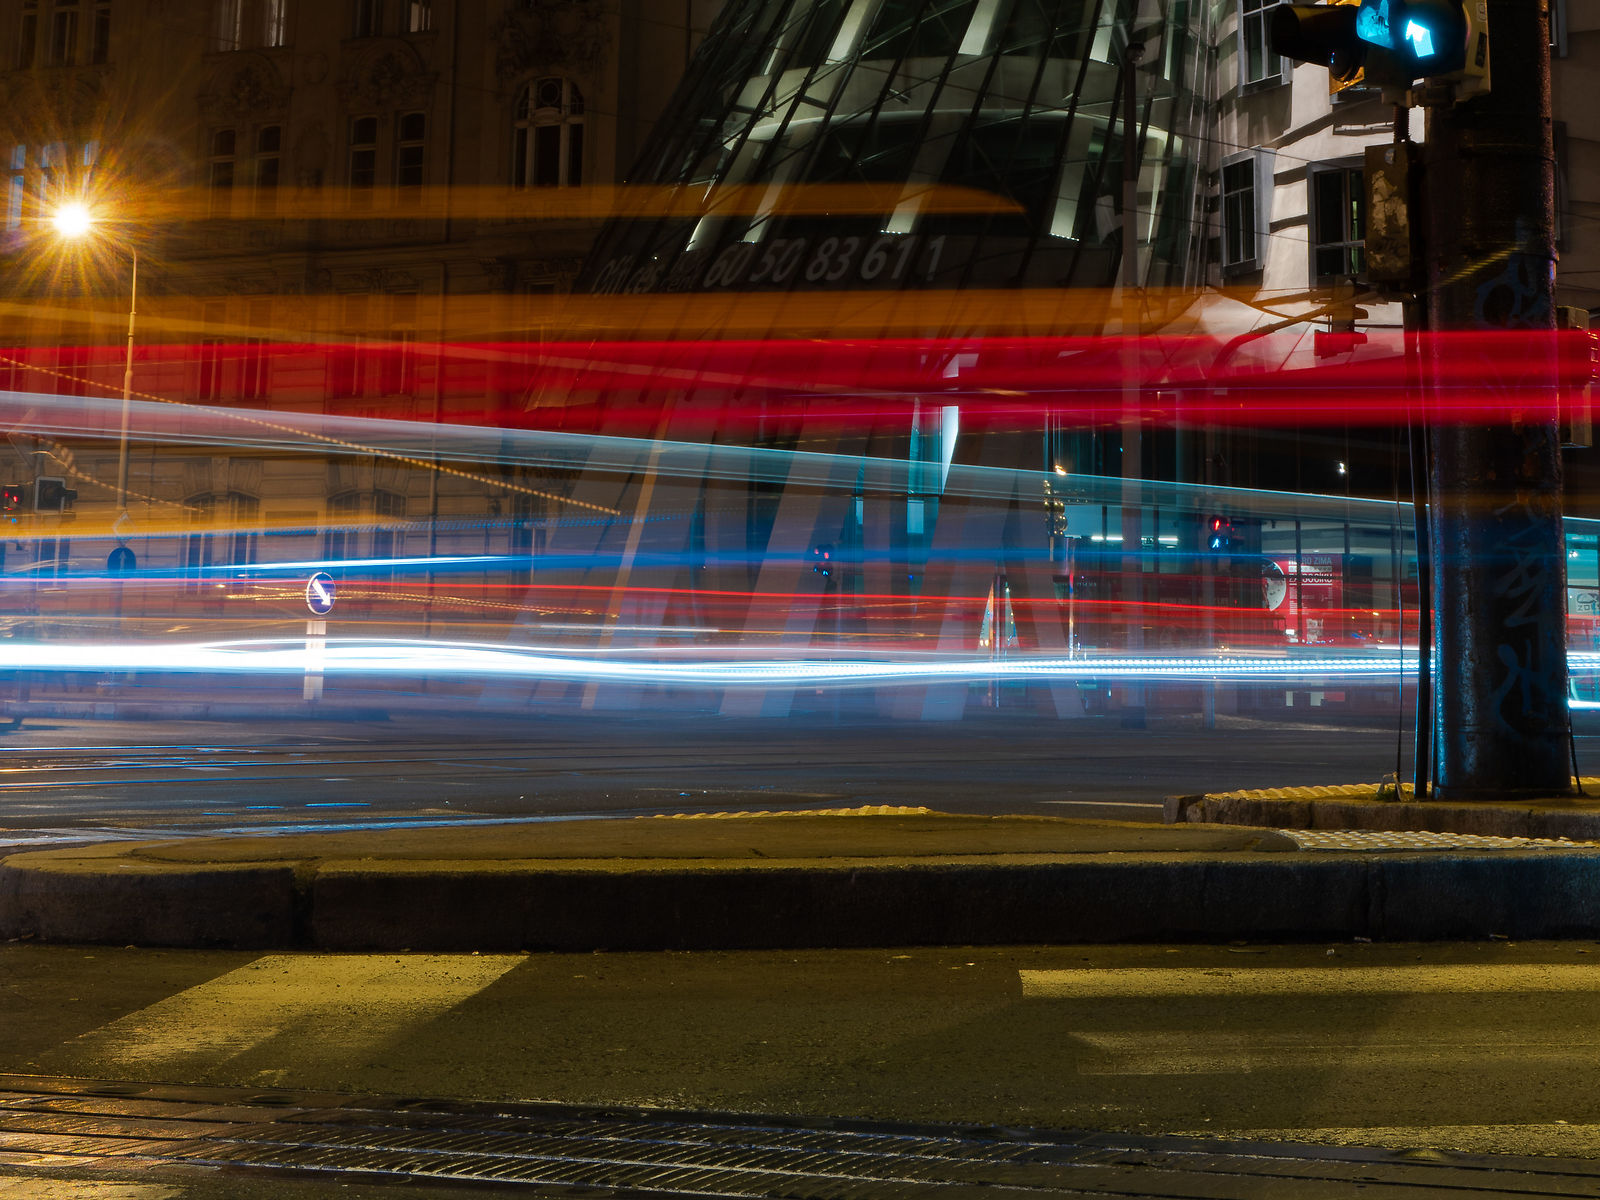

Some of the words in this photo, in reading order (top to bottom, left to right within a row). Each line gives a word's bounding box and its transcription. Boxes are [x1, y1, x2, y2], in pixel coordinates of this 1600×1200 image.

[703, 245, 750, 288] 60
[750, 238, 806, 282] 50
[805, 236, 860, 281] 83
[1313, 556, 1332, 565] ZIMA
